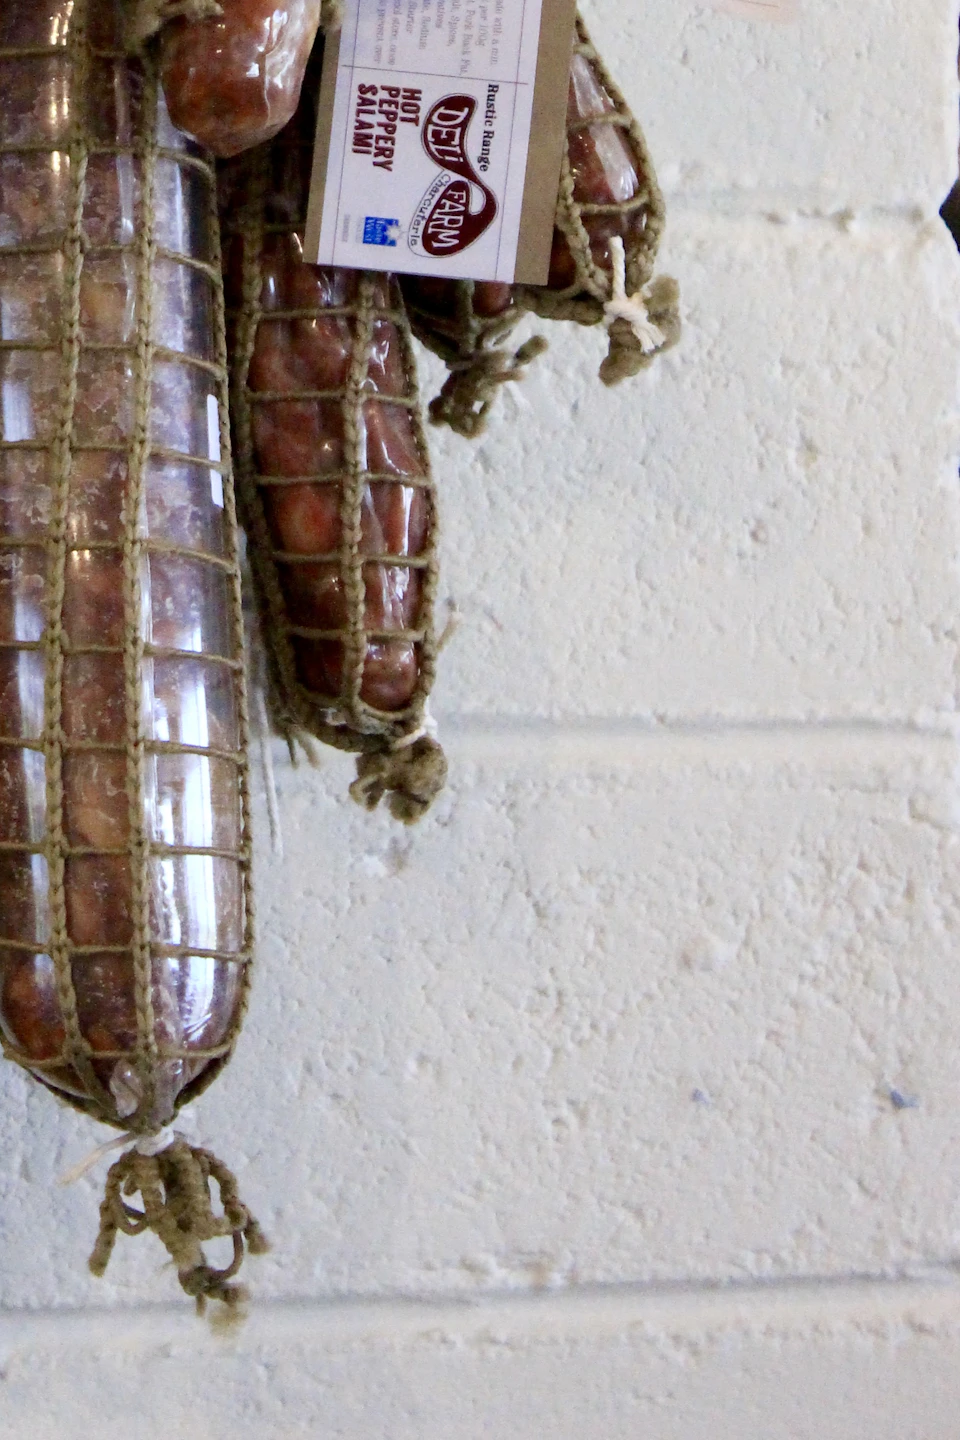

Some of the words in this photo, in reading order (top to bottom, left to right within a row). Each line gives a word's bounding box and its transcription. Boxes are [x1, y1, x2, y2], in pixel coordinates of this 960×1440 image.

[353, 83, 378, 154] SALAMI
[370, 84, 402, 171] PEPPERY
[398, 87, 423, 125] HOT
[482, 83, 499, 127] Rustic
[475, 129, 494, 172] Range
[363, 216, 376, 242] West
[411, 173, 451, 246] Charcuterie
[428, 189, 466, 250] FARM
